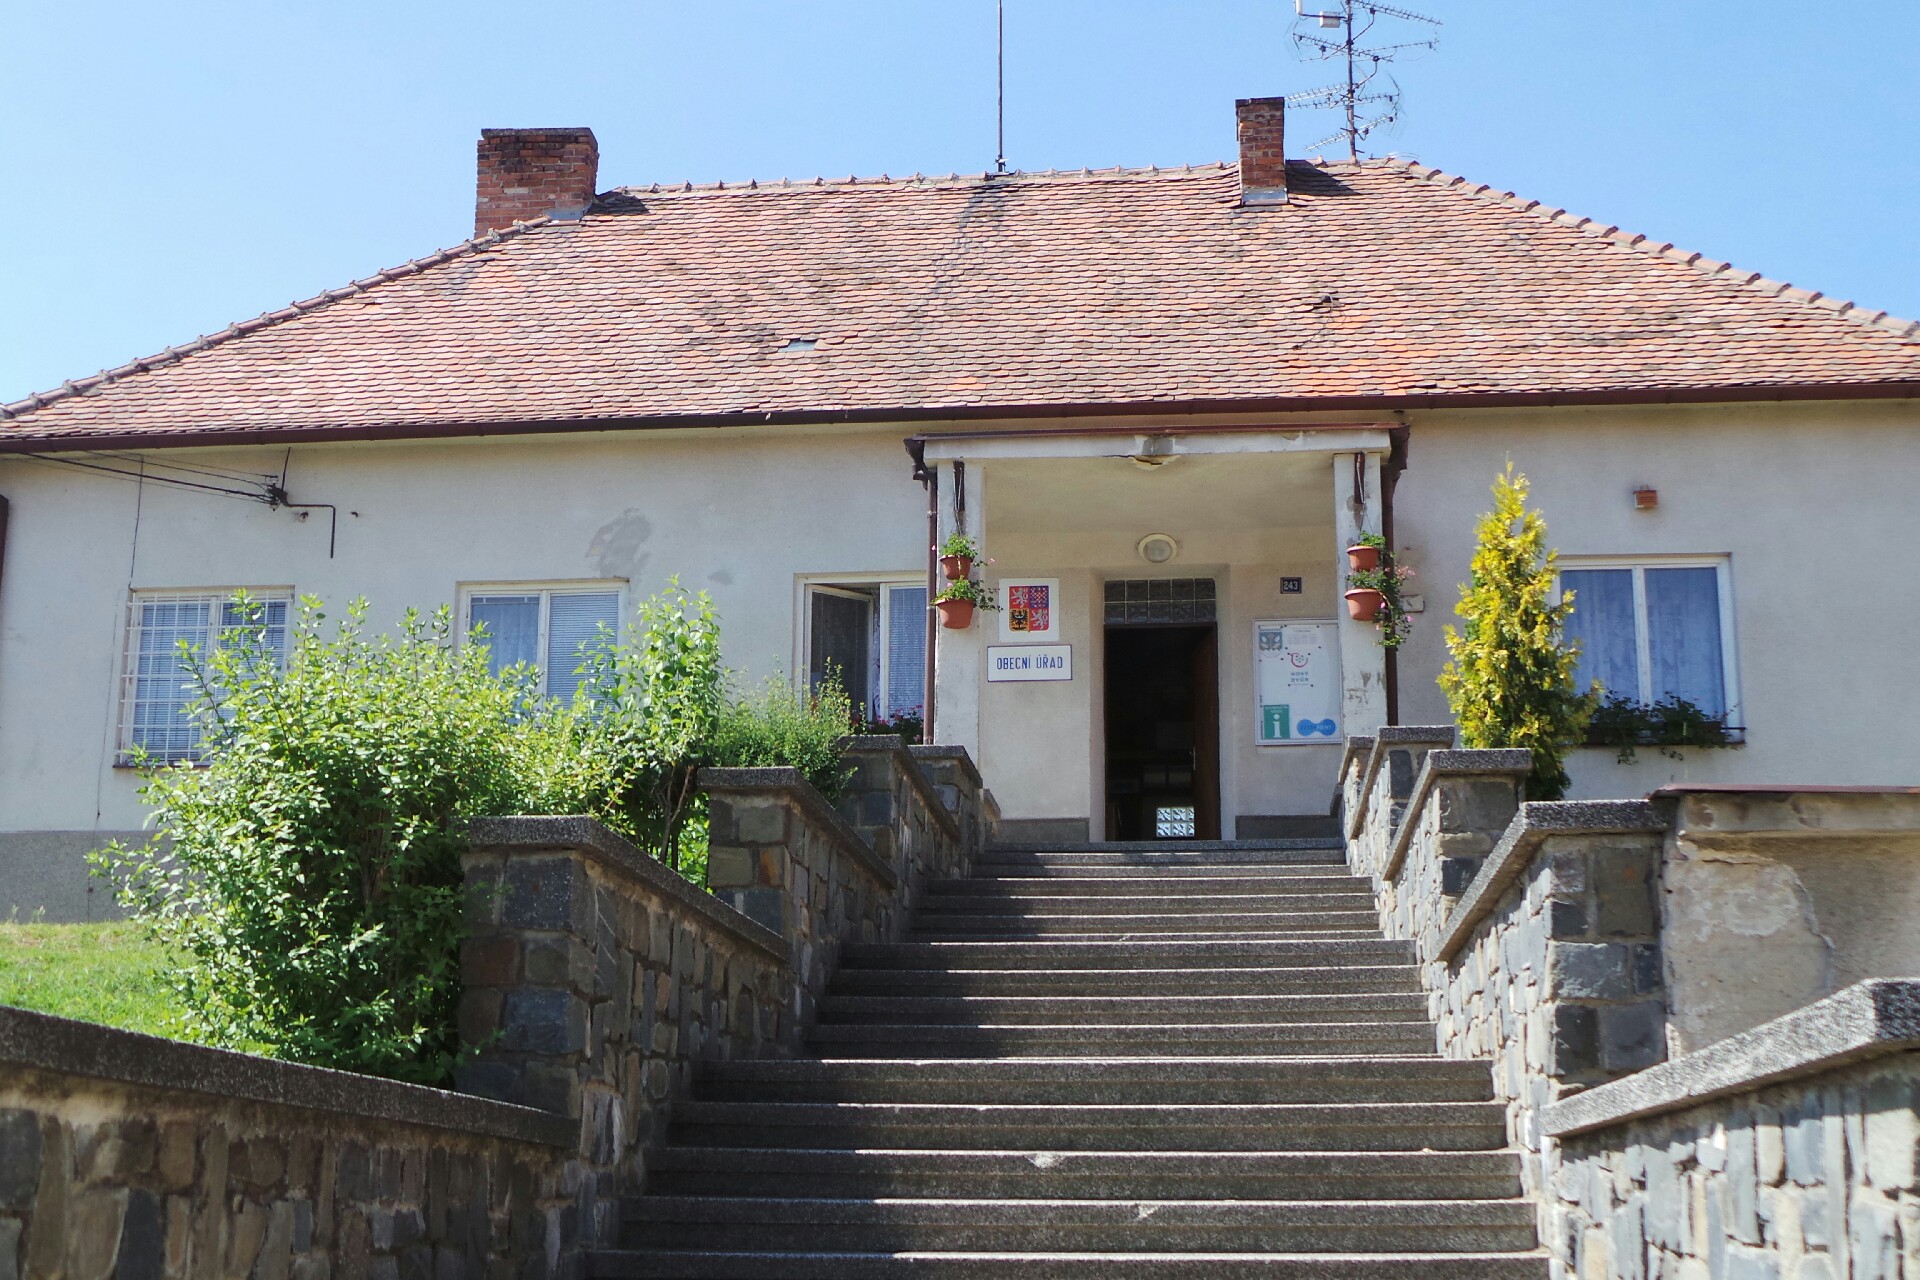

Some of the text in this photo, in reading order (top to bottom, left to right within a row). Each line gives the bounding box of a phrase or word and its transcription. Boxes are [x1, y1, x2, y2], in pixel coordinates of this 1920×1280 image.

[1283, 581, 1298, 590] 243
[996, 654, 1063, 670] OBECNÍ ÚŘAD
